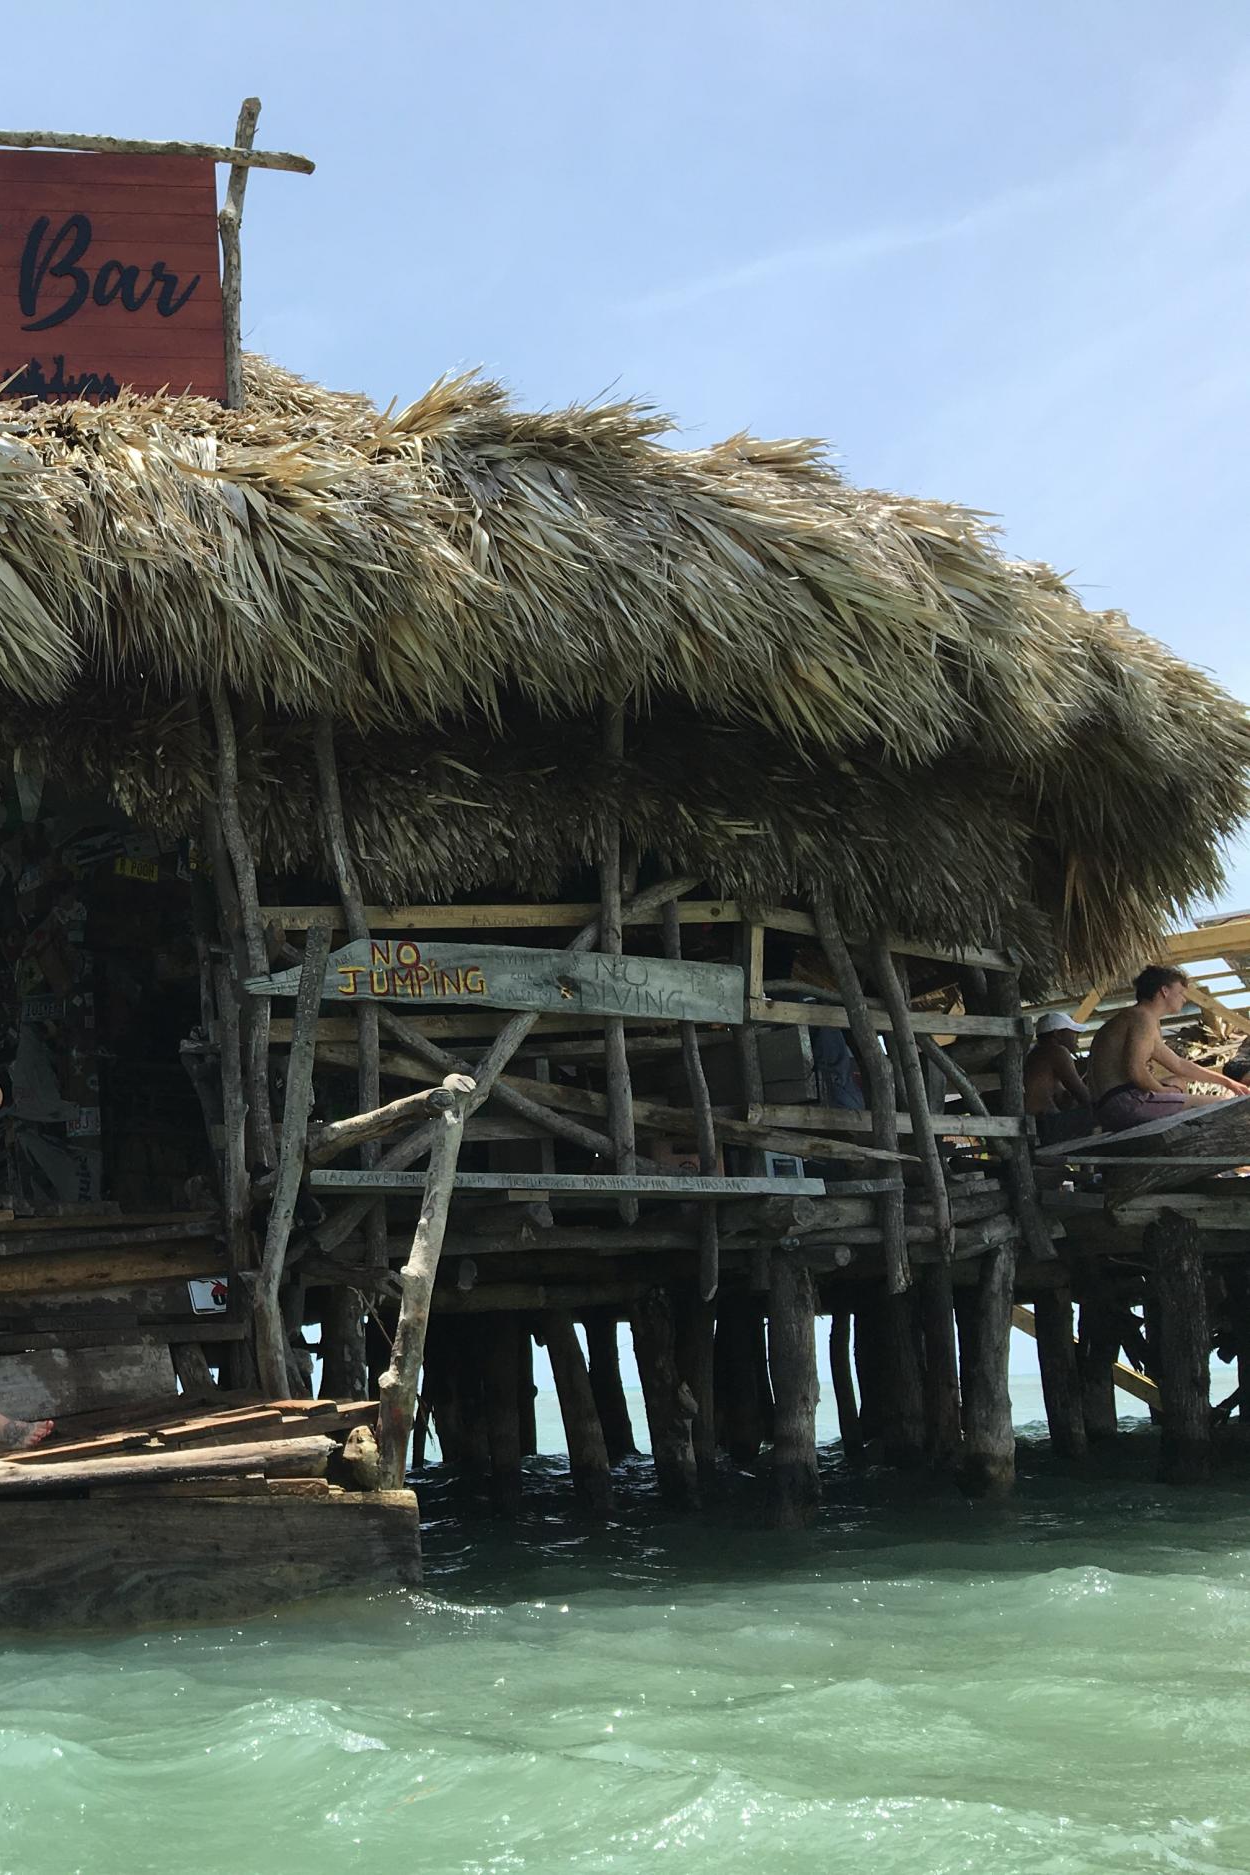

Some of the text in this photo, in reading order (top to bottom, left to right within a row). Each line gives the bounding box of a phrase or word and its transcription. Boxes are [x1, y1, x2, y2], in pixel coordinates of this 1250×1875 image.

[19, 214, 201, 331] Bar
[370, 940, 421, 968] NO
[595, 956, 648, 986] NO
[579, 981, 686, 1019] DIVING
